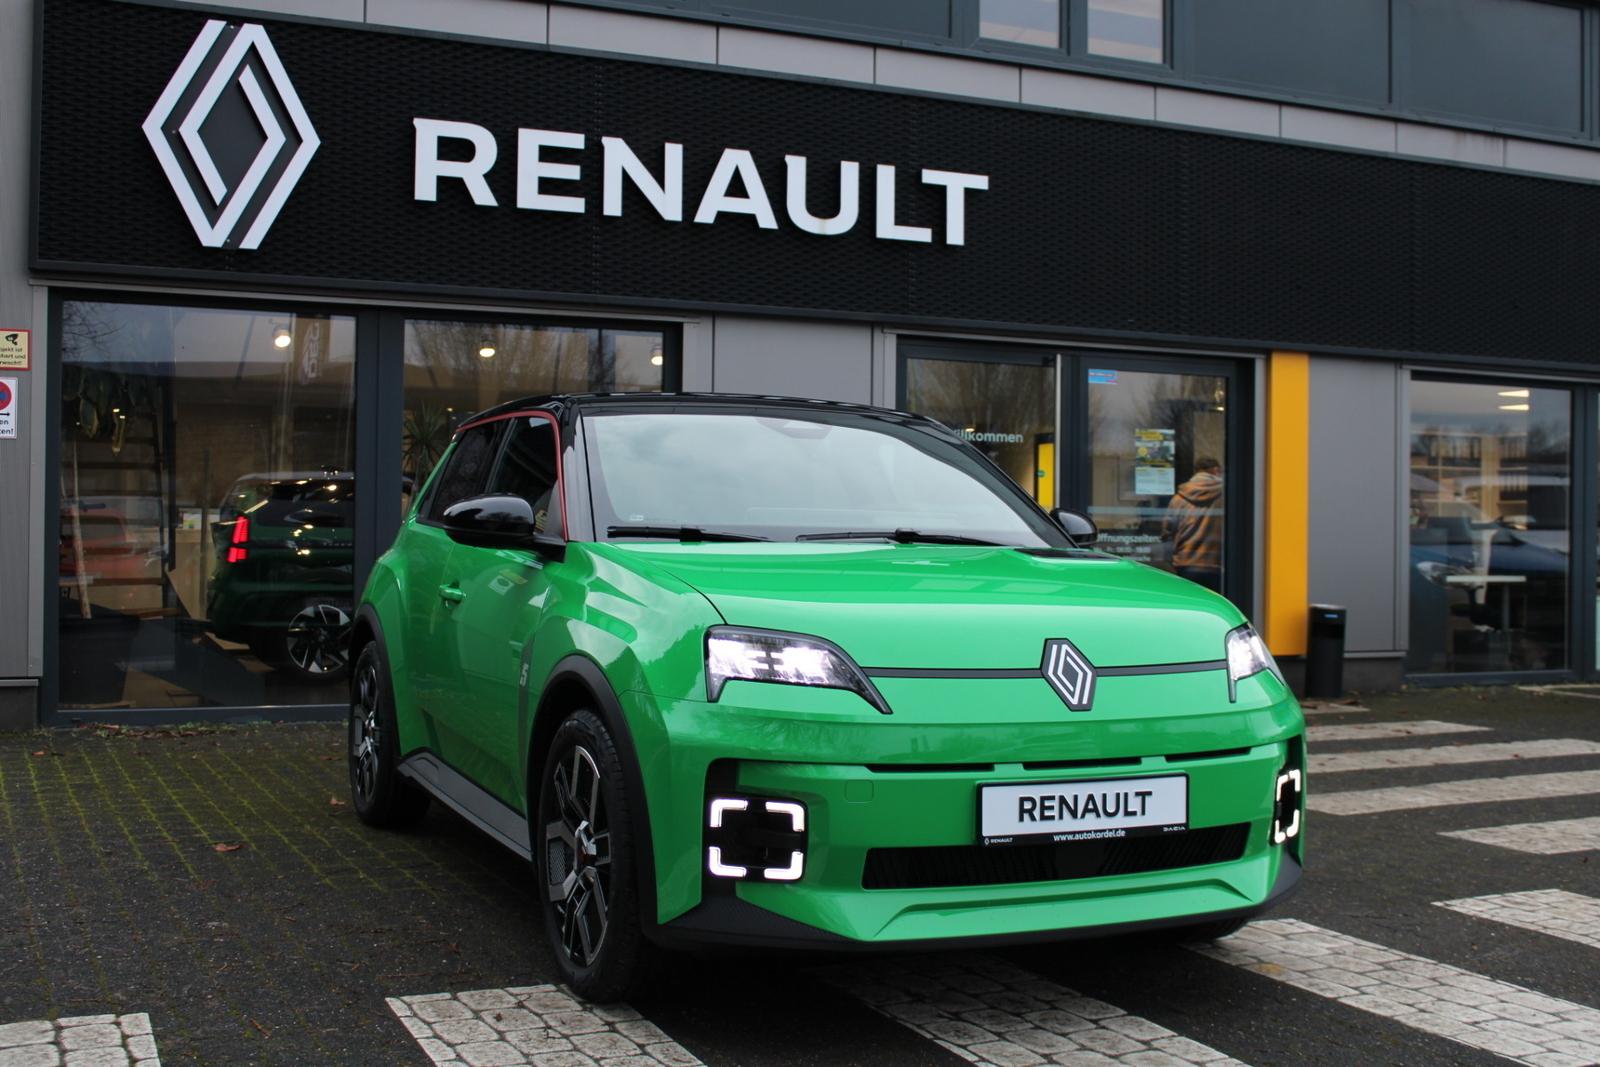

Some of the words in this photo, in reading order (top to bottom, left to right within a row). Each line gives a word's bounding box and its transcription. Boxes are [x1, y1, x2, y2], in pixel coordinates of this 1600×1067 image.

[413, 117, 990, 246] RENAULT
[1018, 790, 1153, 823] RENAULT
[1053, 829, 1126, 842] www.autokordel.de
